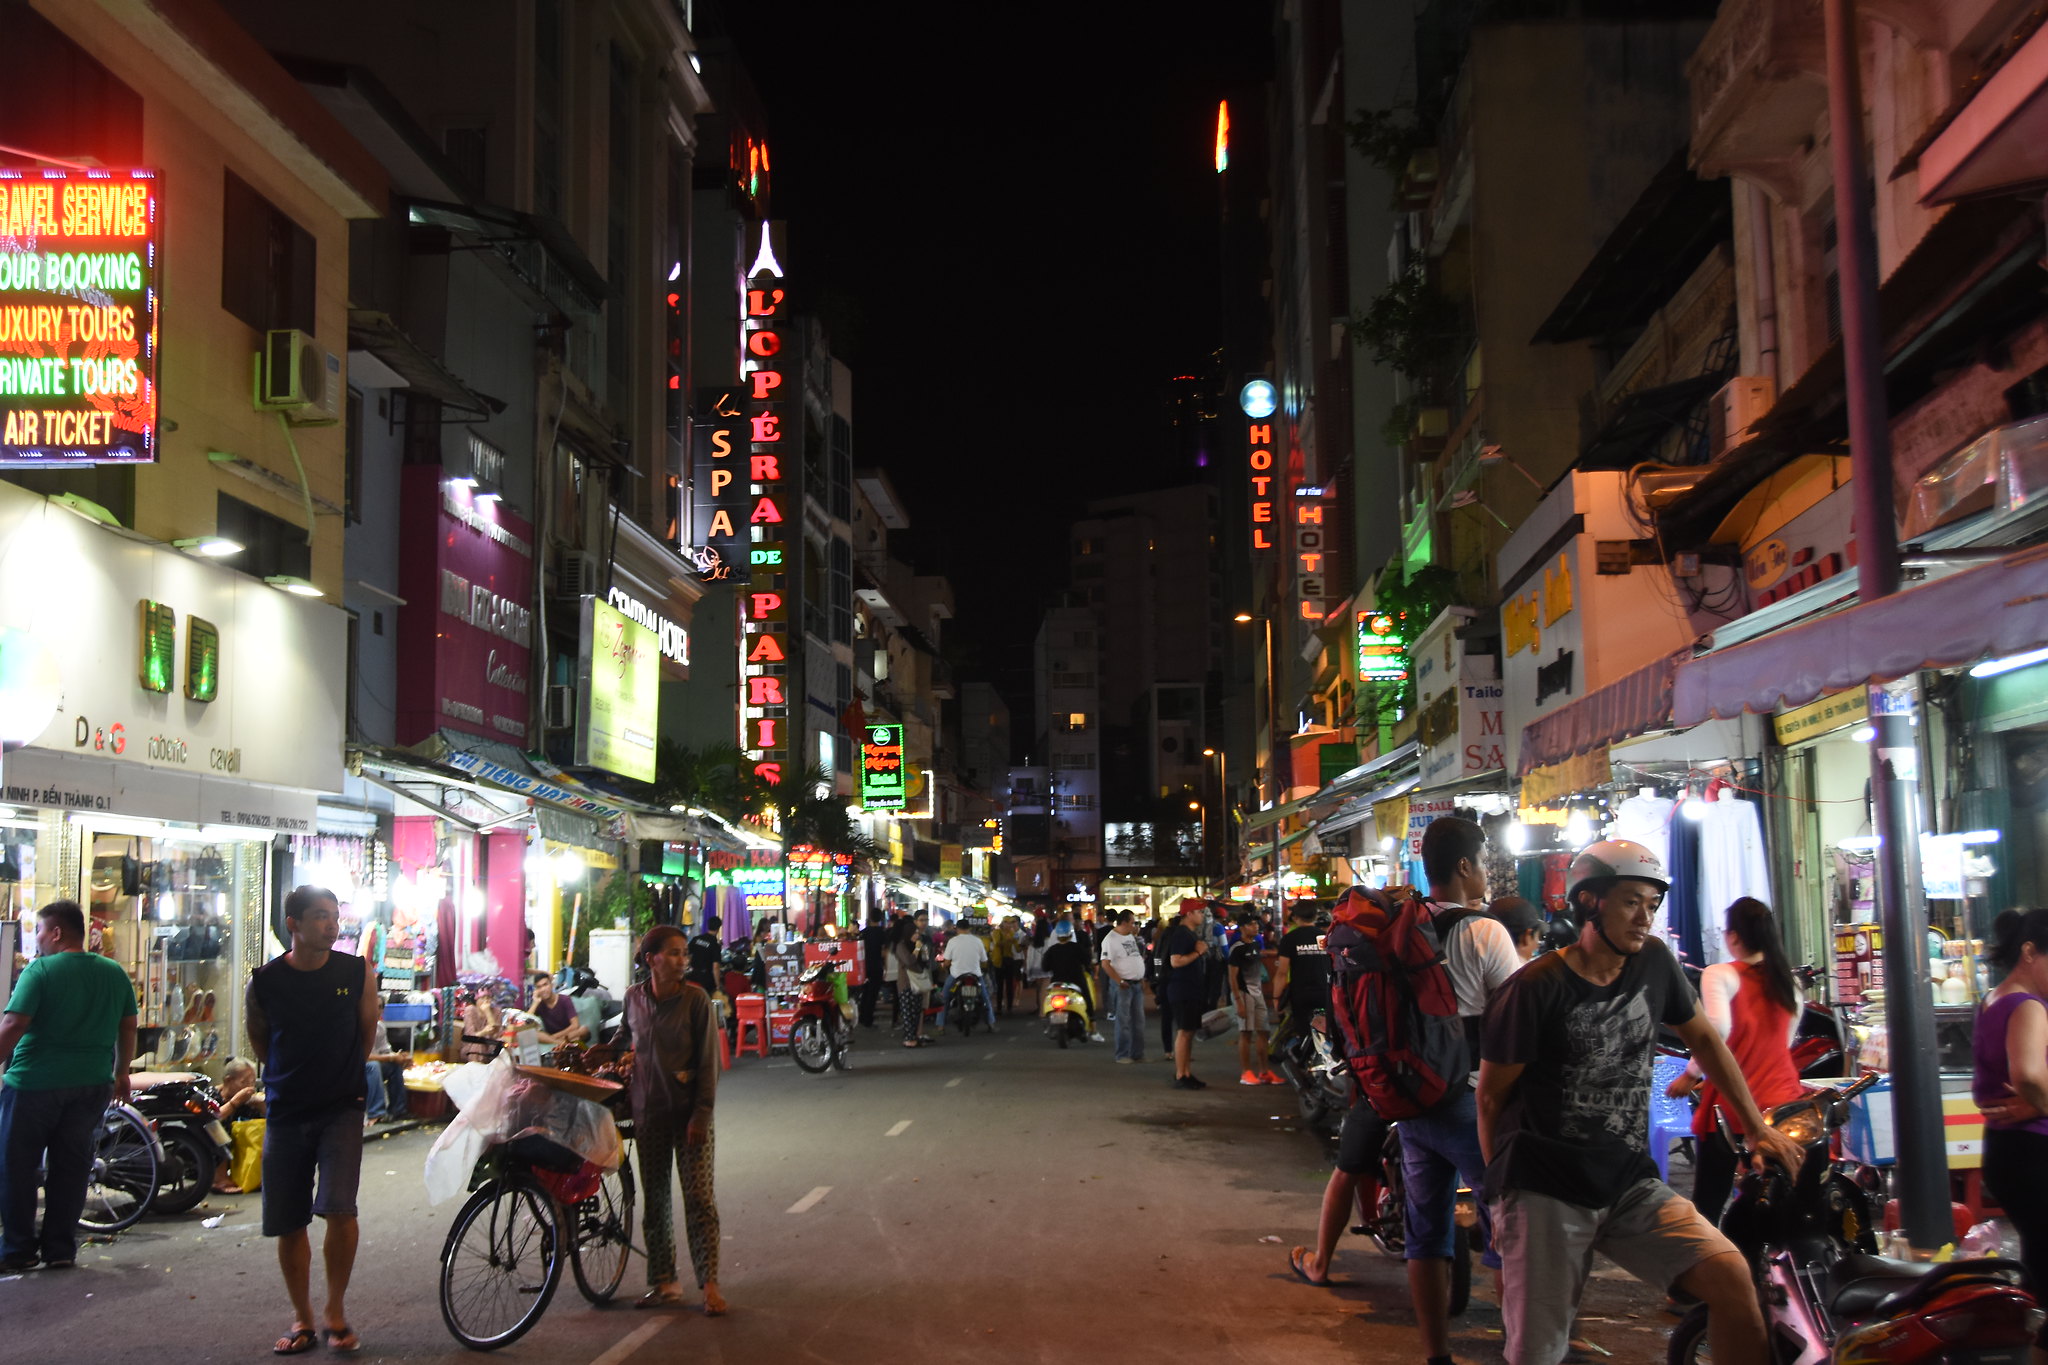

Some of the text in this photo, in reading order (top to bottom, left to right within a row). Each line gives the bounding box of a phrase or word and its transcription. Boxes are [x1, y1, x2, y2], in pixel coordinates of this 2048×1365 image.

[62, 183, 147, 237] SERVICE
[45, 251, 142, 291] BOOKING
[67, 304, 135, 342] TOURS
[70, 356, 138, 395] TOURS
[4, 409, 115, 447] AIR TICKET
[708, 429, 735, 538] SPA
[1249, 424, 1273, 549] HOTEL
[750, 549, 783, 566] DE
[1298, 505, 1324, 620] HOTEL
[658, 616, 690, 667] HOTEL
[1480, 711, 1505, 736] M
[76, 715, 89, 747] D
[109, 721, 127, 755] G
[147, 734, 187, 764] roberto
[210, 746, 242, 774] cavalli
[1465, 744, 1506, 770] SA
[42, 784, 62, 805] BẾN
[64, 789, 94, 809] THÀNH
[1408, 800, 1454, 814] BIG SALE
[966, 917, 988, 926] EDAP
